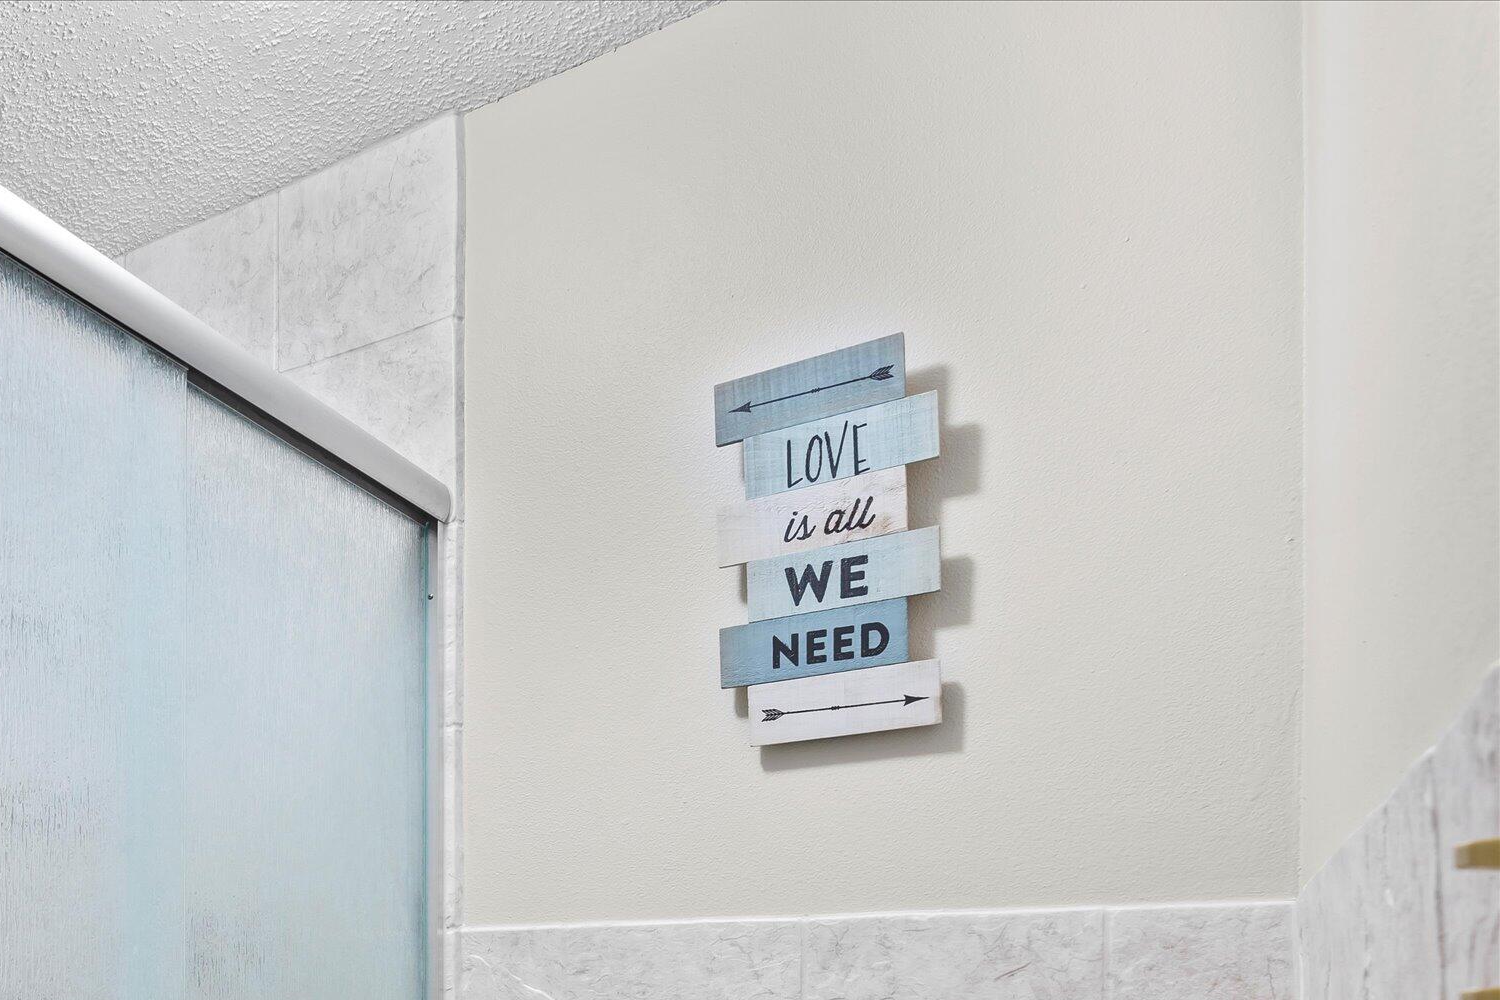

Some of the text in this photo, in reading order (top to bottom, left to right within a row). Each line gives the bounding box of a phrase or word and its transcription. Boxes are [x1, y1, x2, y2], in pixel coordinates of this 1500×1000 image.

[786, 420, 871, 489] LOVE
[783, 496, 876, 543] is all
[784, 554, 869, 607] WE
[772, 621, 890, 669] NEED
